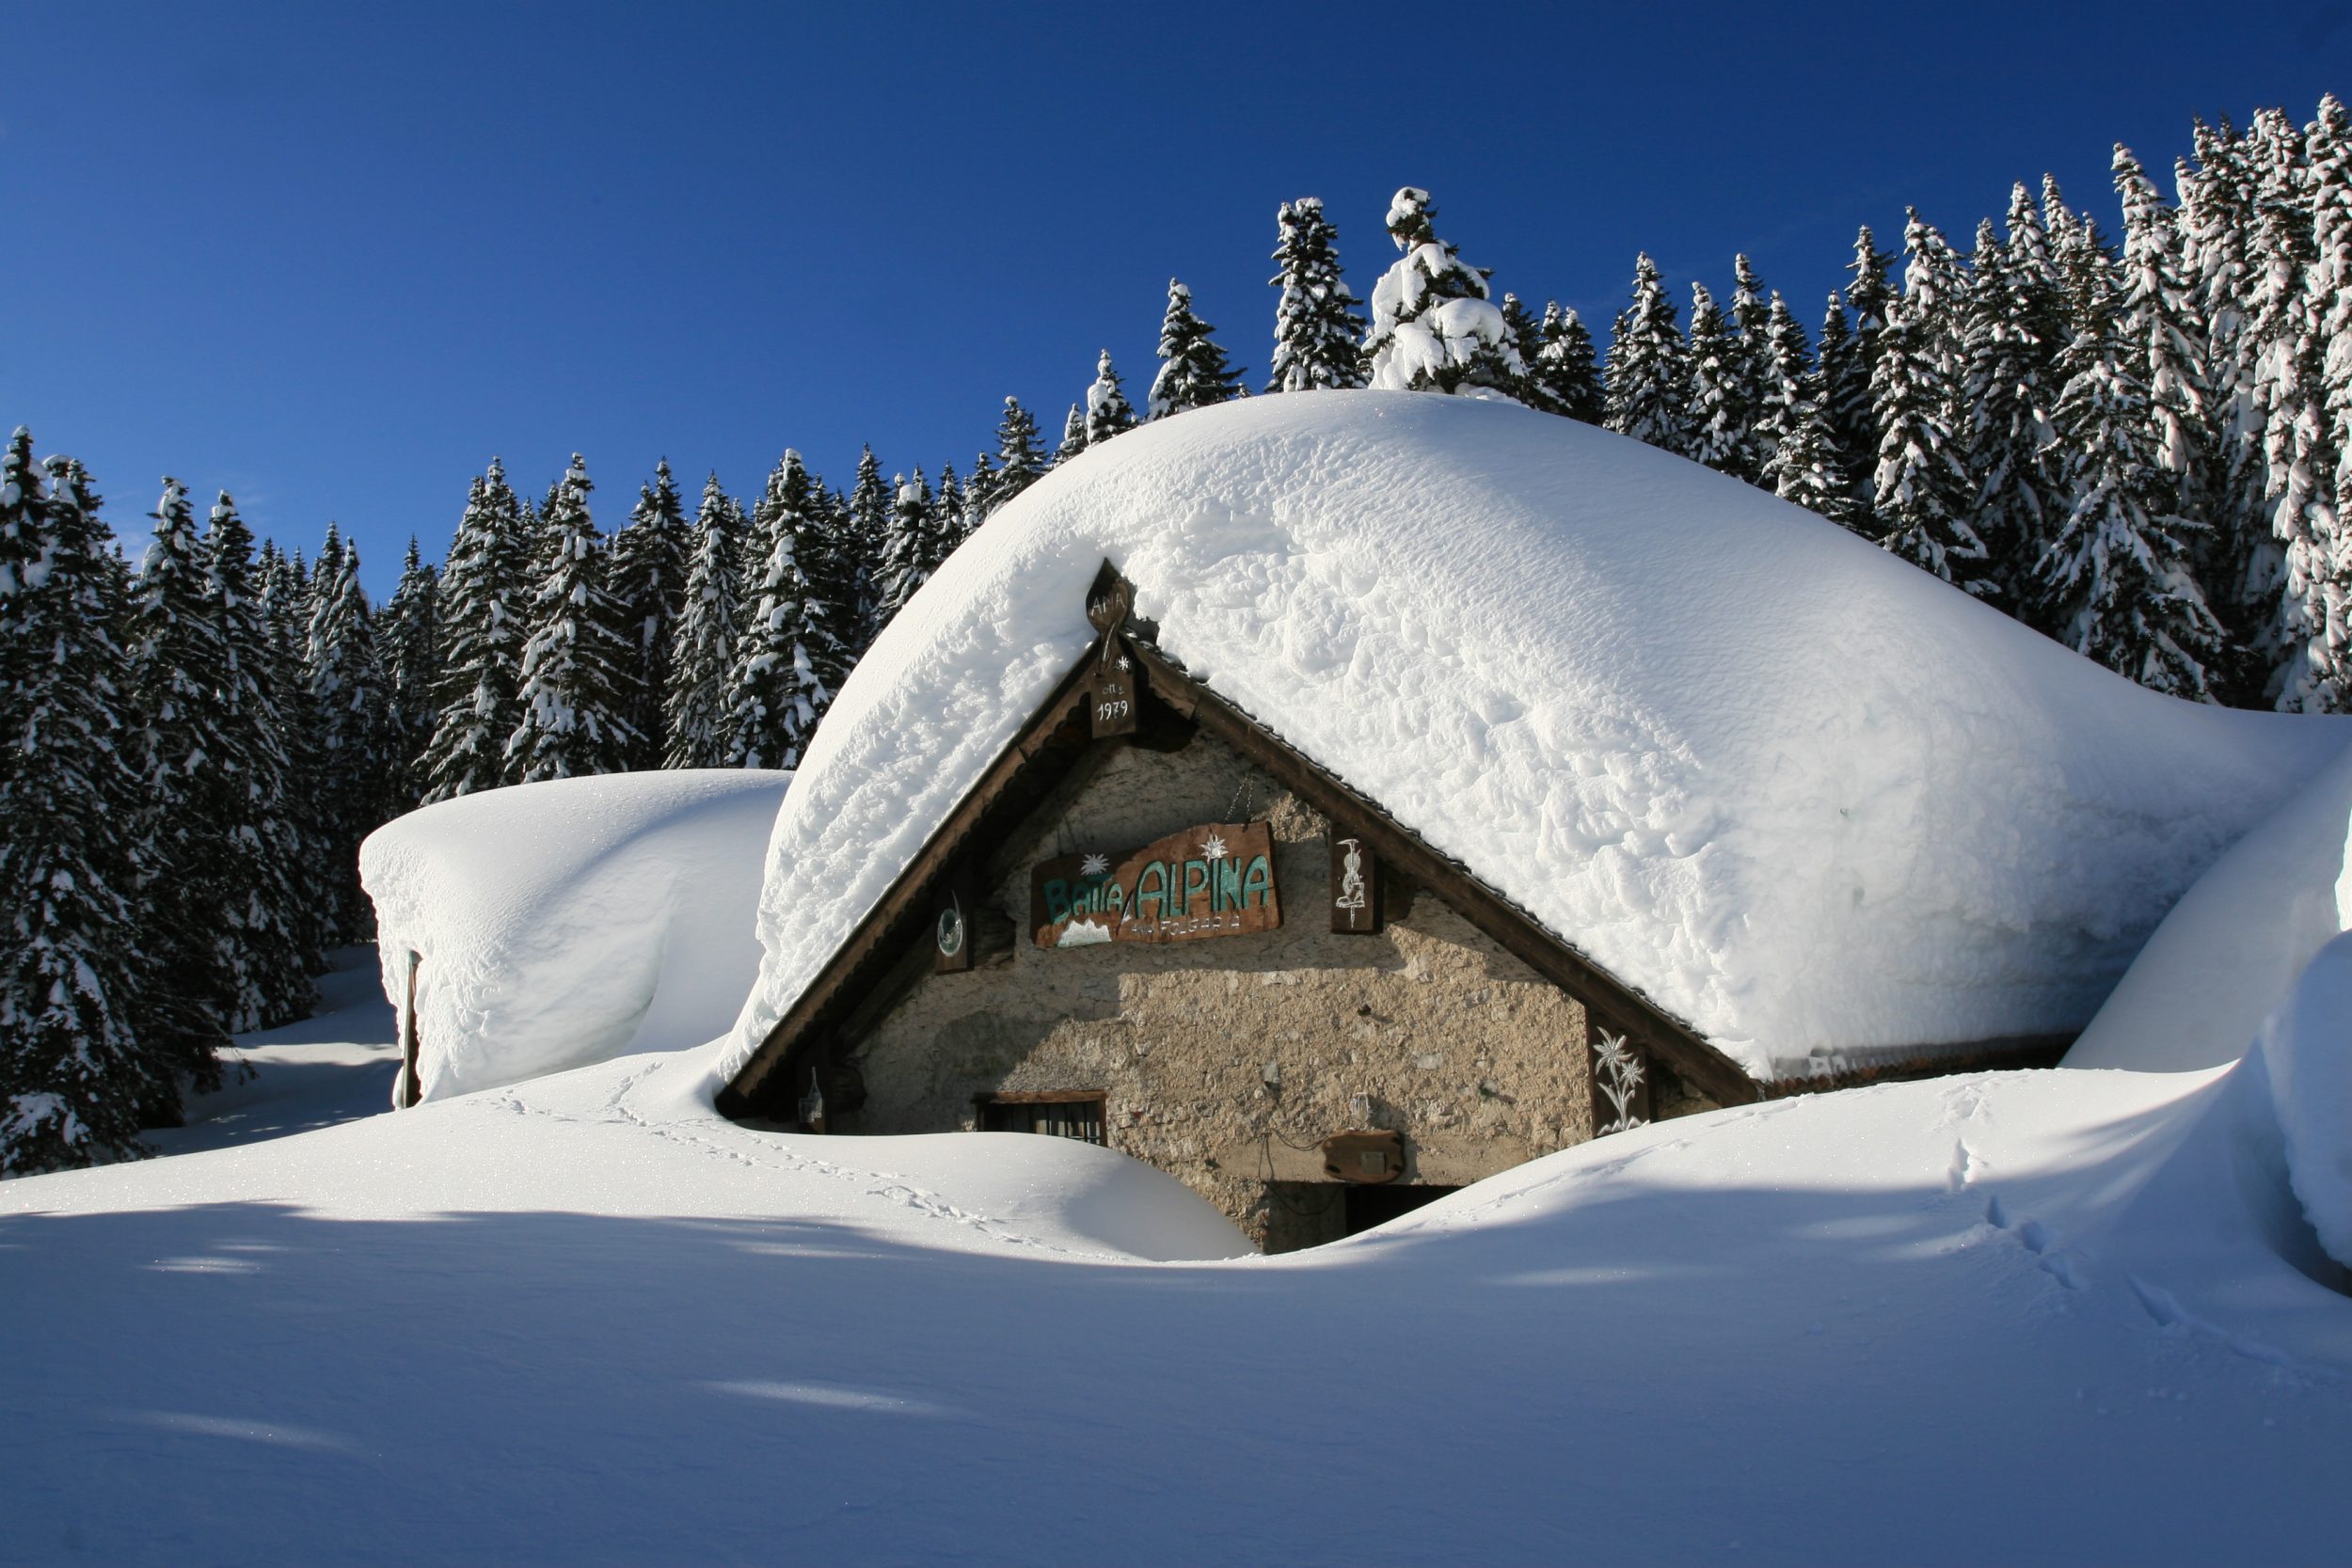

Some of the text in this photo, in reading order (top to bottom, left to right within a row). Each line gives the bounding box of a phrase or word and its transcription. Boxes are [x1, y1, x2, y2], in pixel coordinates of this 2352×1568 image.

[1097, 700, 1128, 721] 1979
[1043, 854, 1269, 925] BAITA ALPINA
[1160, 915, 1241, 936] FOLGARA
